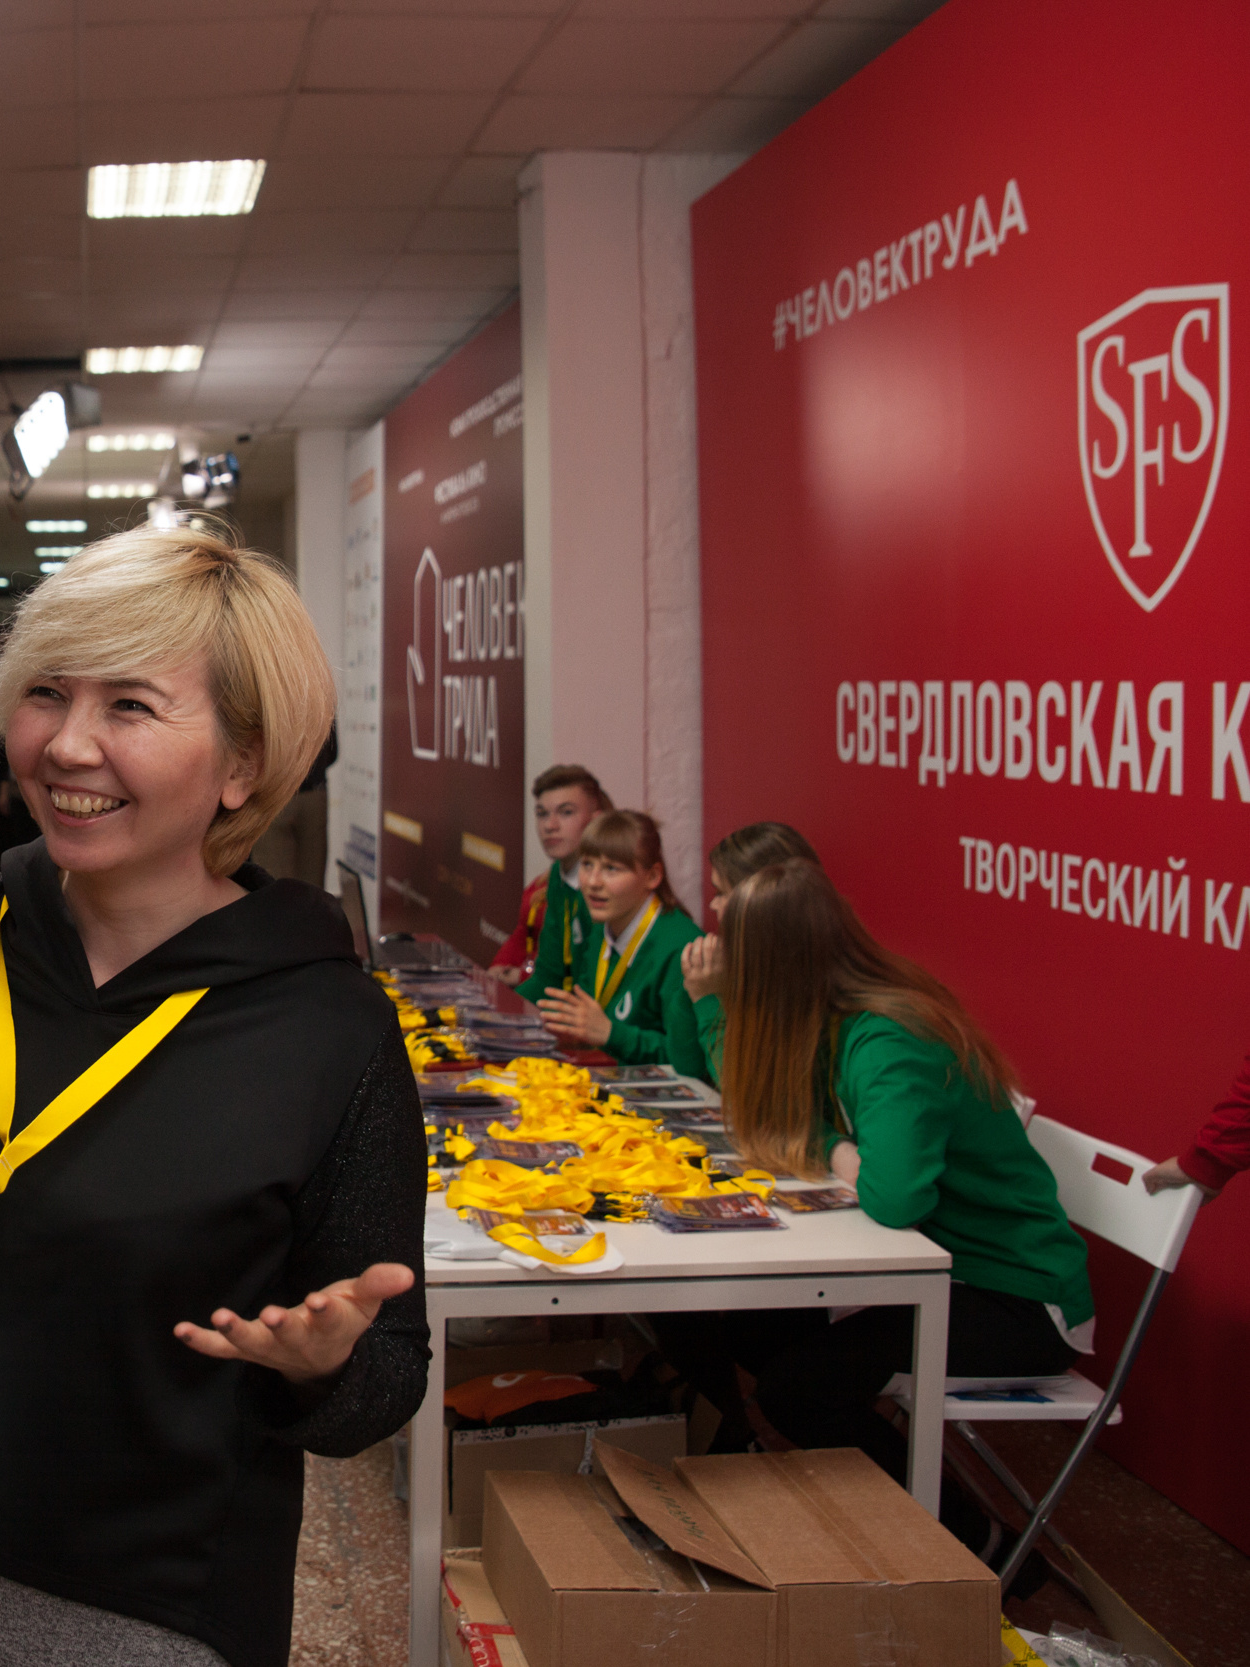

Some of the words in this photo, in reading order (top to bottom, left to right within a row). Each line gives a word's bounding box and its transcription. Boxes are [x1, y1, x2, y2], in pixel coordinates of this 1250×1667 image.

[772, 178, 1030, 351] #ЧЕЛОВЕКТРУДА
[1090, 307, 1216, 559] SFS
[442, 675, 501, 769] ТРУДА
[835, 680, 1185, 796] СВЕРДЛОВСКАЯ
[959, 836, 1191, 939] ТВОРЧЕСКИЙ
